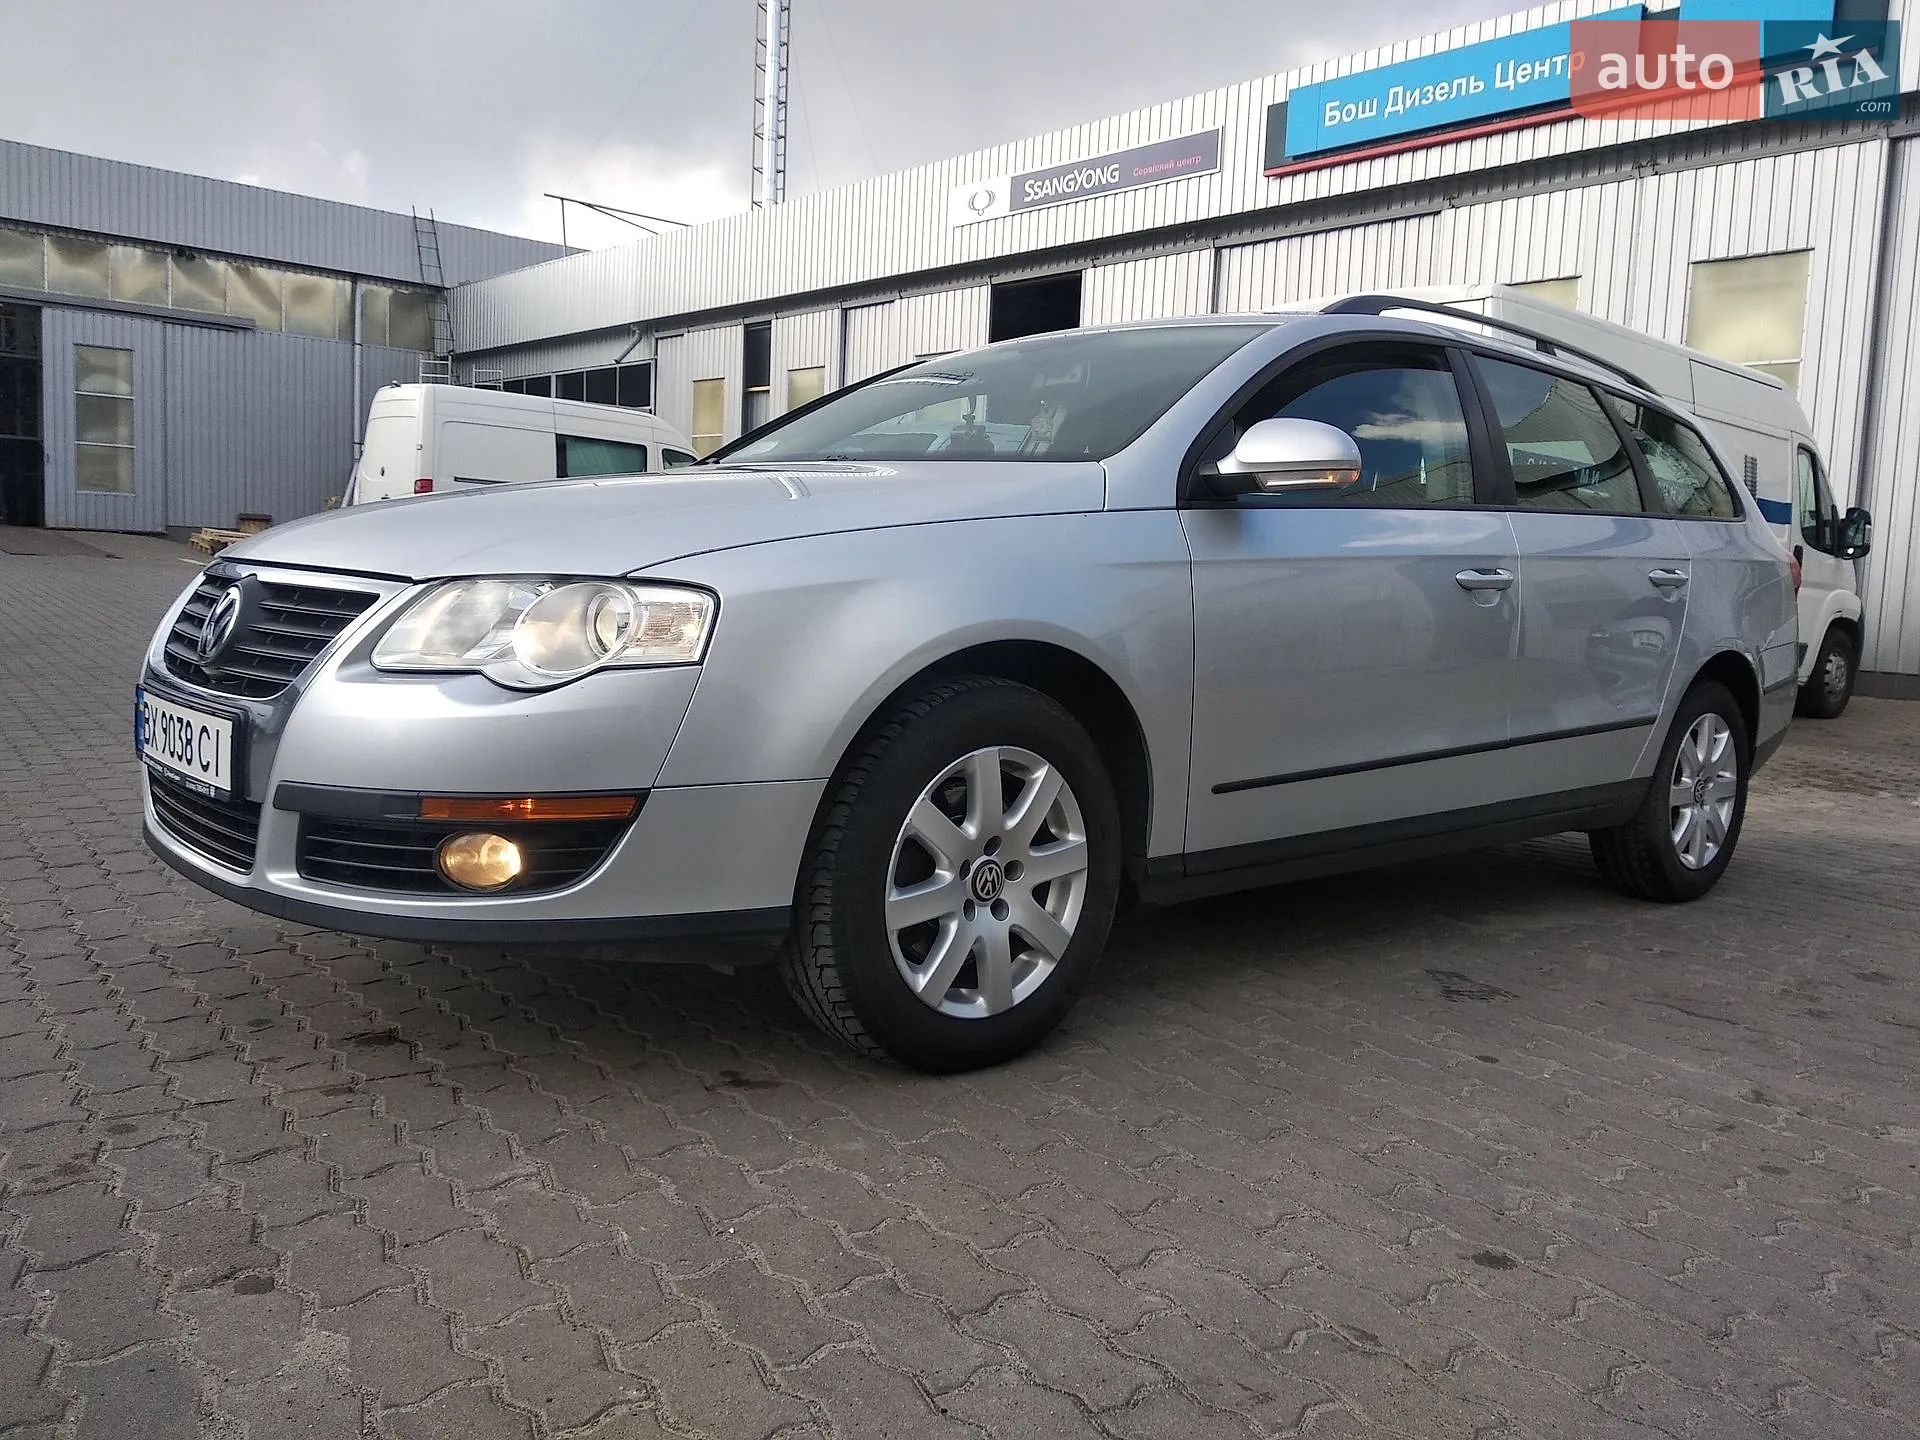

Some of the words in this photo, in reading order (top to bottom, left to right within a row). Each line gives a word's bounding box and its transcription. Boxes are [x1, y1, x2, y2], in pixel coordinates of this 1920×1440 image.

[1324, 98, 1378, 127] Бош
[1384, 75, 1485, 117] Дизель
[1494, 51, 1586, 90] Центр
[161, 710, 193, 766] 9038
[198, 725, 219, 777] CI
